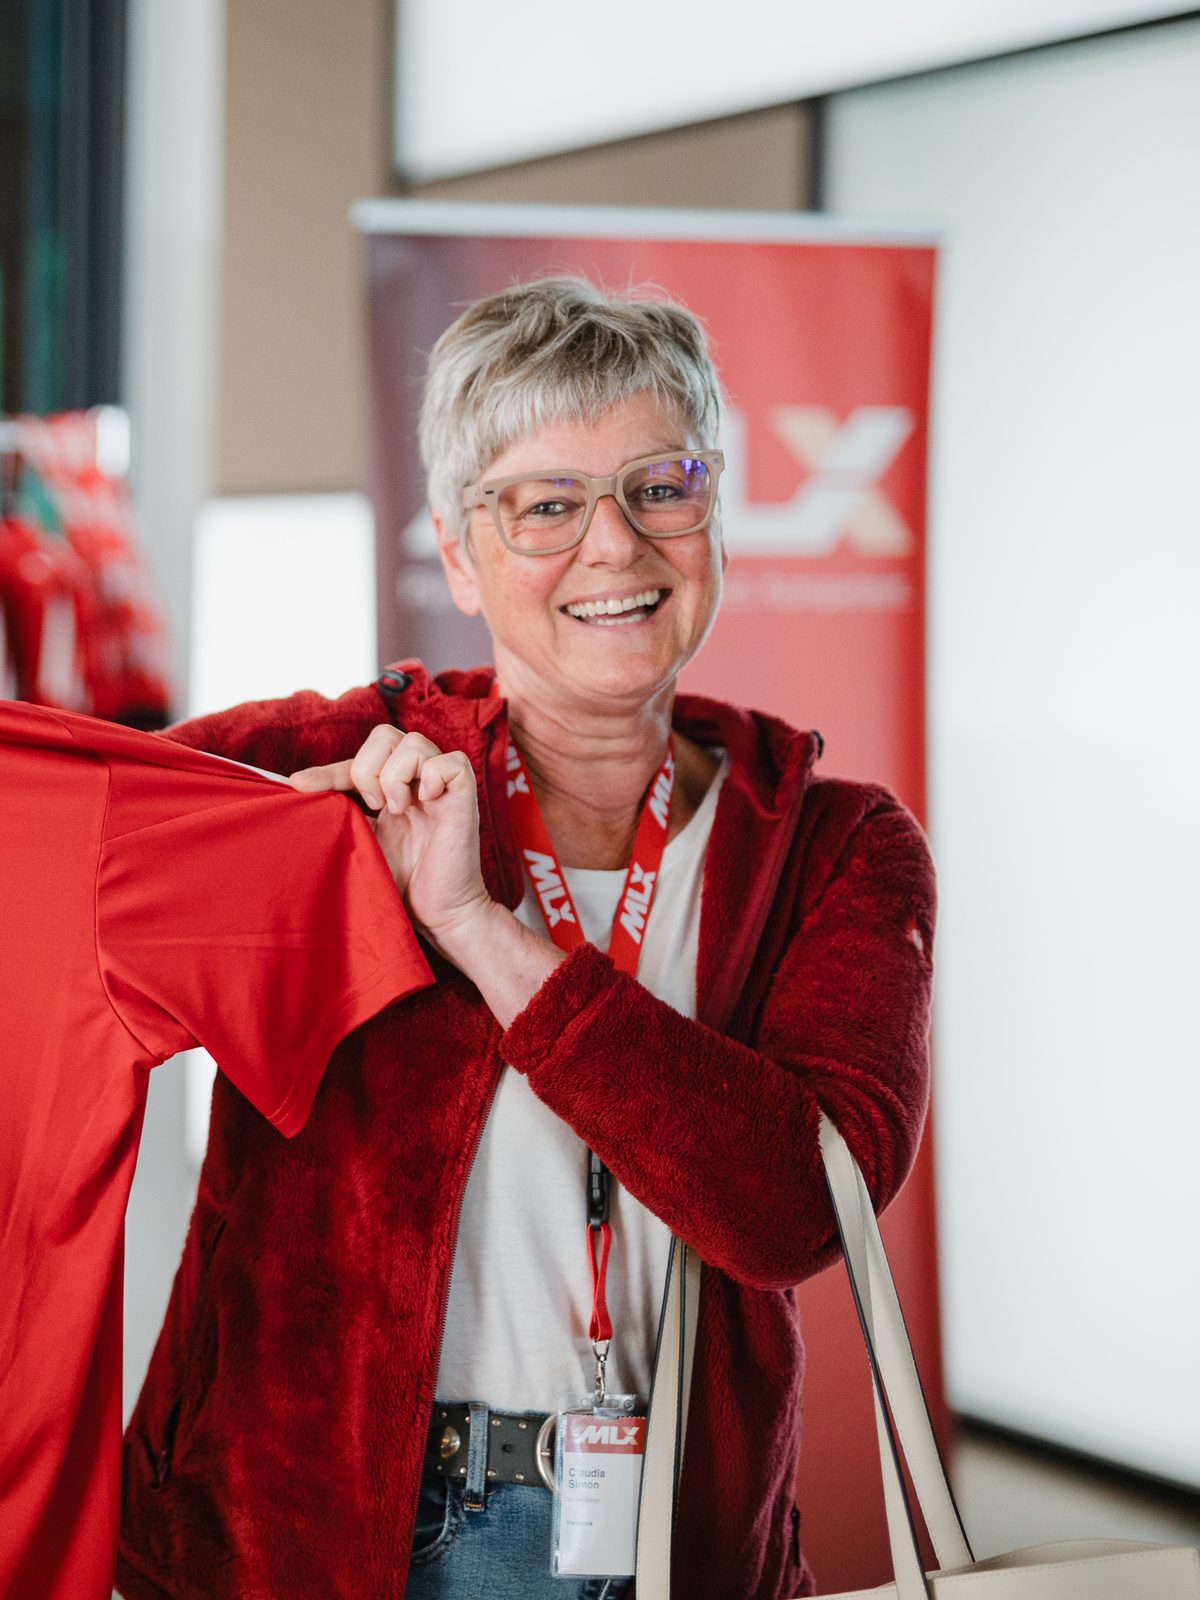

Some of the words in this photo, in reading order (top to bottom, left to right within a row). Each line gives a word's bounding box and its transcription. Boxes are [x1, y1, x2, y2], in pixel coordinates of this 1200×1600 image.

[523, 849, 576, 928] MLX
[619, 862, 657, 945] MLX
[574, 1425, 640, 1446] MLX
[568, 1467, 606, 1478] Caudia
[568, 1479, 600, 1489] Simon
